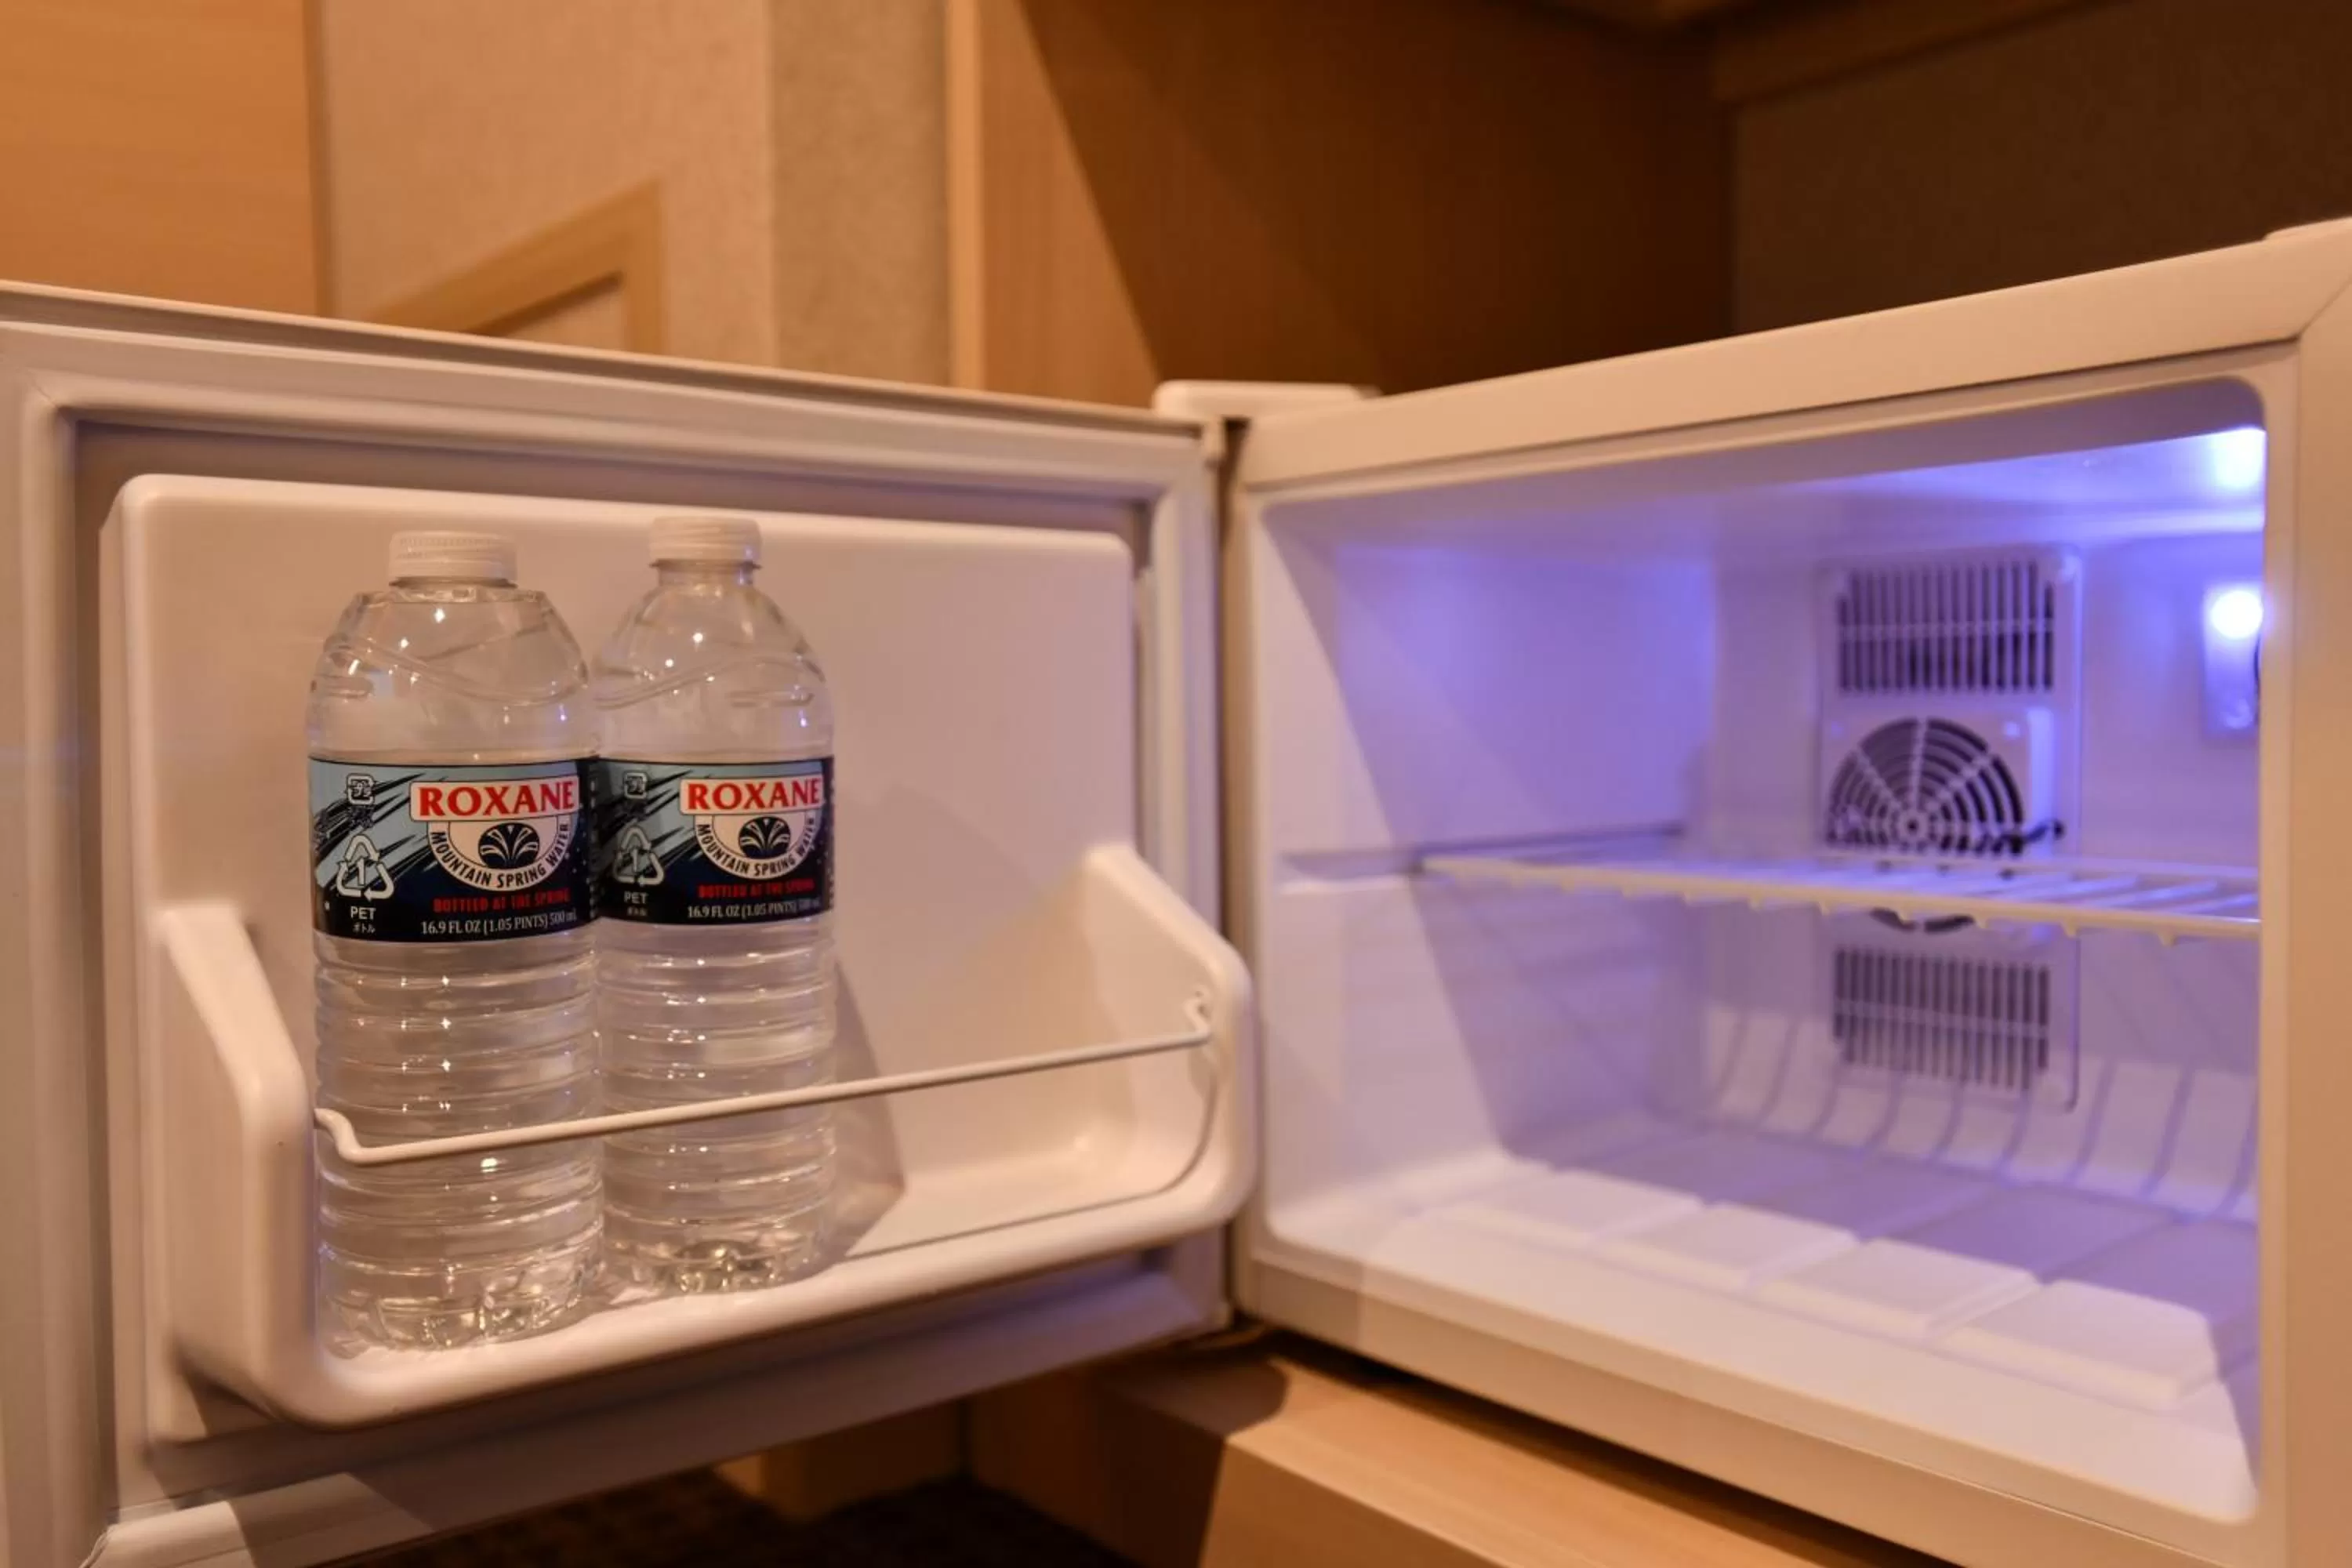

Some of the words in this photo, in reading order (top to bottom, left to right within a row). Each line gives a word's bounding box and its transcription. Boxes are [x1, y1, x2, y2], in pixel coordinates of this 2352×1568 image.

[419, 781, 575, 817] ROXANE
[687, 778, 821, 811] ROXANE
[430, 830, 492, 887] MOUNTAIN
[496, 863, 546, 888] SPRING
[545, 824, 568, 866] WATER
[698, 823, 750, 875] MOUNTAIN
[753, 853, 796, 877] SPRING
[624, 890, 648, 905] PET
[350, 906, 376, 920] PET
[688, 905, 710, 918] 16.9
[711, 906, 724, 918] FL
[725, 904, 741, 918] OZ
[421, 920, 447, 935] 16.9
[448, 920, 464, 935] FL
[465, 919, 481, 934] OZ
